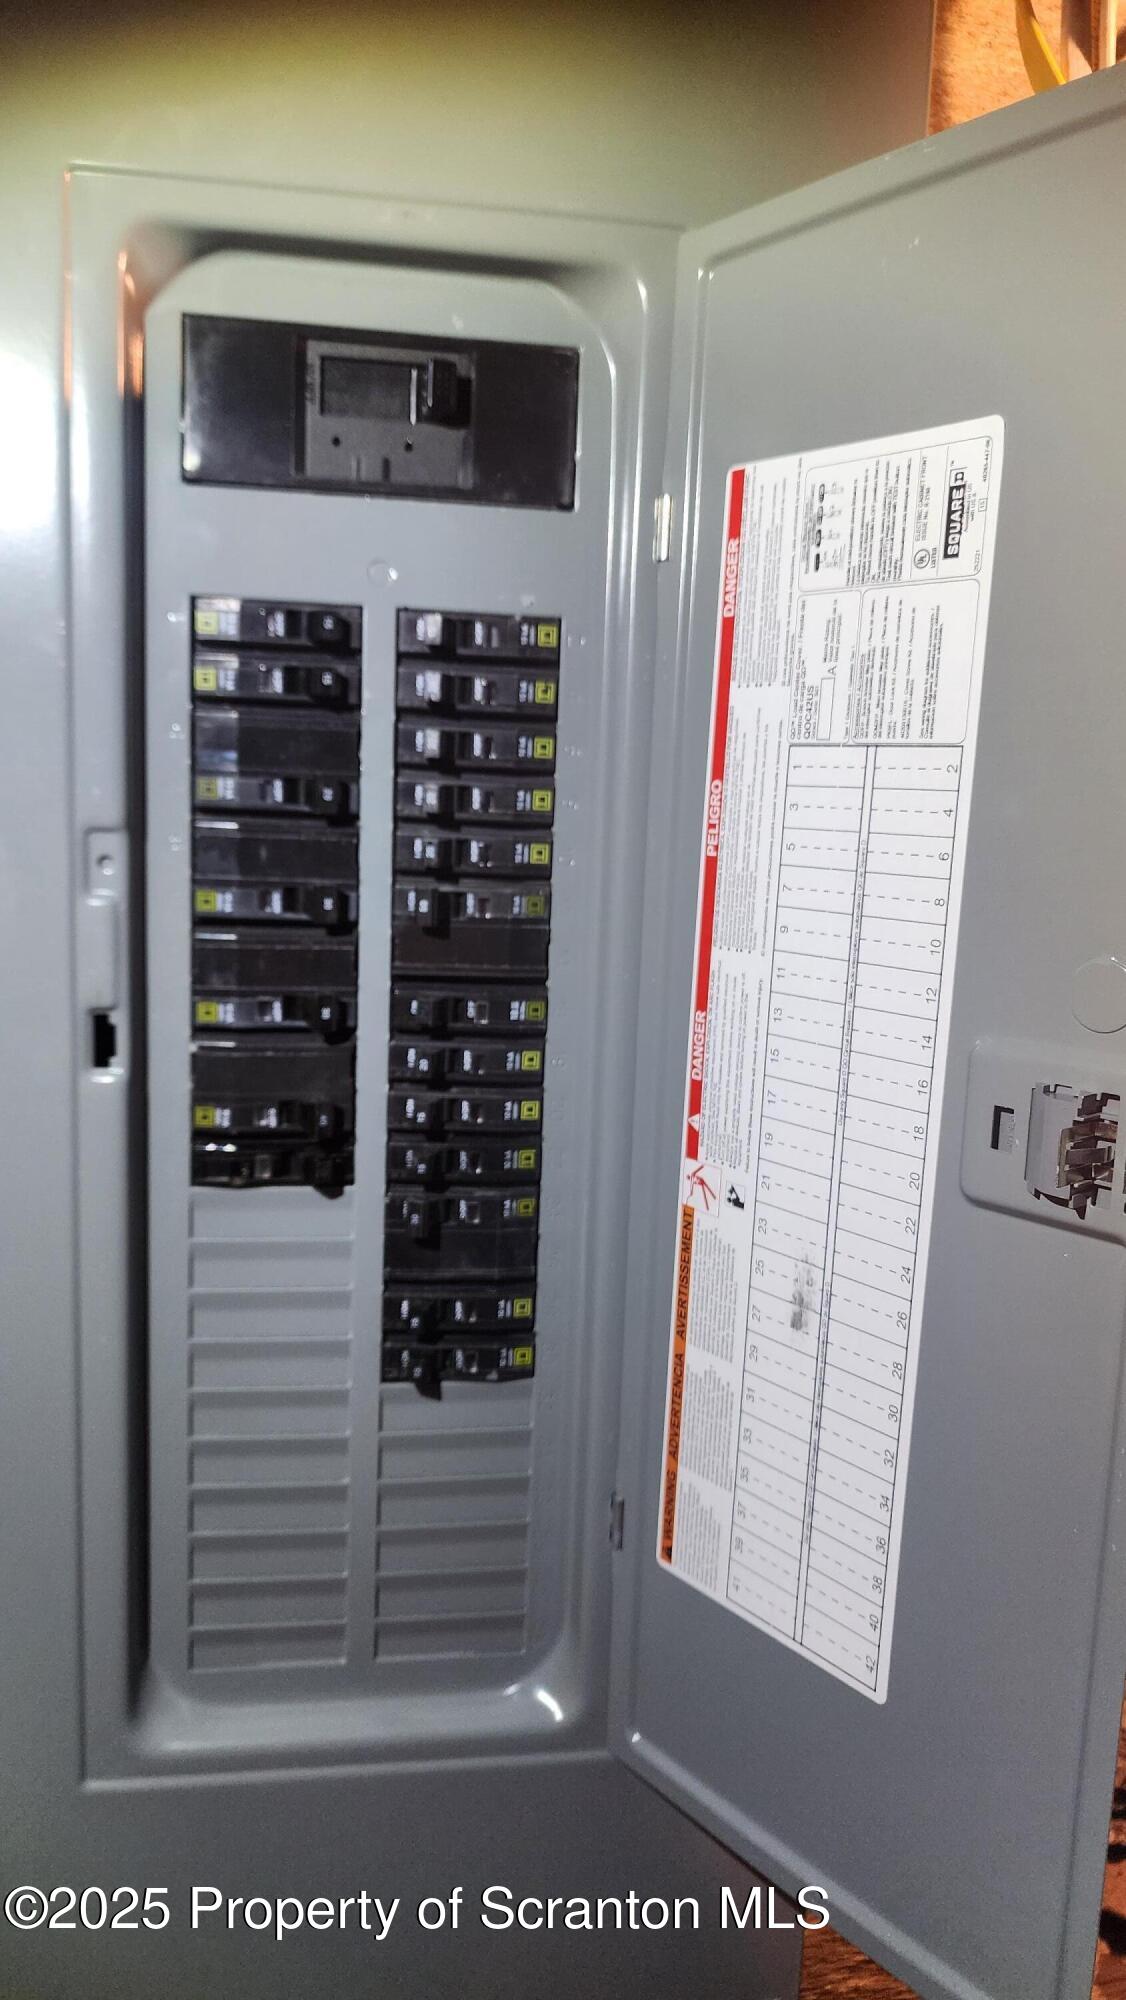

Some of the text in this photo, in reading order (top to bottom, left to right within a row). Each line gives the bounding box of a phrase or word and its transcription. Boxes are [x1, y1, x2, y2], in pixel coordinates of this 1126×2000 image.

[947, 472, 964, 556] SQUARE D
[723, 538, 738, 617] DANGER
[828, 666, 836, 676] A
[804, 686, 814, 739] QOC42US
[946, 764, 960, 776] 2
[788, 804, 798, 812] 3
[943, 809, 954, 817] 4
[706, 780, 722, 857] PELIGRO
[786, 842, 796, 852] 5
[939, 852, 950, 861] 6
[782, 884, 792, 892] 7
[935, 898, 946, 907] 8
[780, 926, 788, 934] 9
[931, 939, 941, 955] 10
[776, 968, 786, 978] 11
[926, 988, 938, 1003] 12
[774, 1008, 782, 1022] 13
[692, 1010, 706, 1081] DANGER
[922, 1035, 932, 1050] 14
[770, 1048, 780, 1062] 15
[918, 1080, 928, 1095] 16
[766, 1090, 776, 1104] 17
[764, 1132, 774, 1146] 19
[914, 1126, 924, 1141] 18
[760, 1176, 770, 1190] 21
[909, 1172, 920, 1190] 20
[758, 1218, 768, 1234] 23
[905, 1217, 916, 1235] 22
[754, 1258, 764, 1276] 25
[901, 1266, 911, 1284] 24
[752, 1304, 760, 1322] 27
[897, 1312, 908, 1330] 26
[748, 1344, 758, 1362] 29
[663, 1208, 693, 1542] WARNING ADVERTENCIA AVERTISSEMENT
[892, 1362, 902, 1379] 28
[888, 1405, 898, 1423] 30
[884, 1450, 894, 1468] 32
[738, 1500, 746, 1518] 37
[880, 1494, 890, 1512] 34
[876, 1537, 886, 1554] 36
[872, 1576, 882, 1593] 38
[869, 1614, 879, 1631] 40
[865, 1656, 875, 1673] 42
